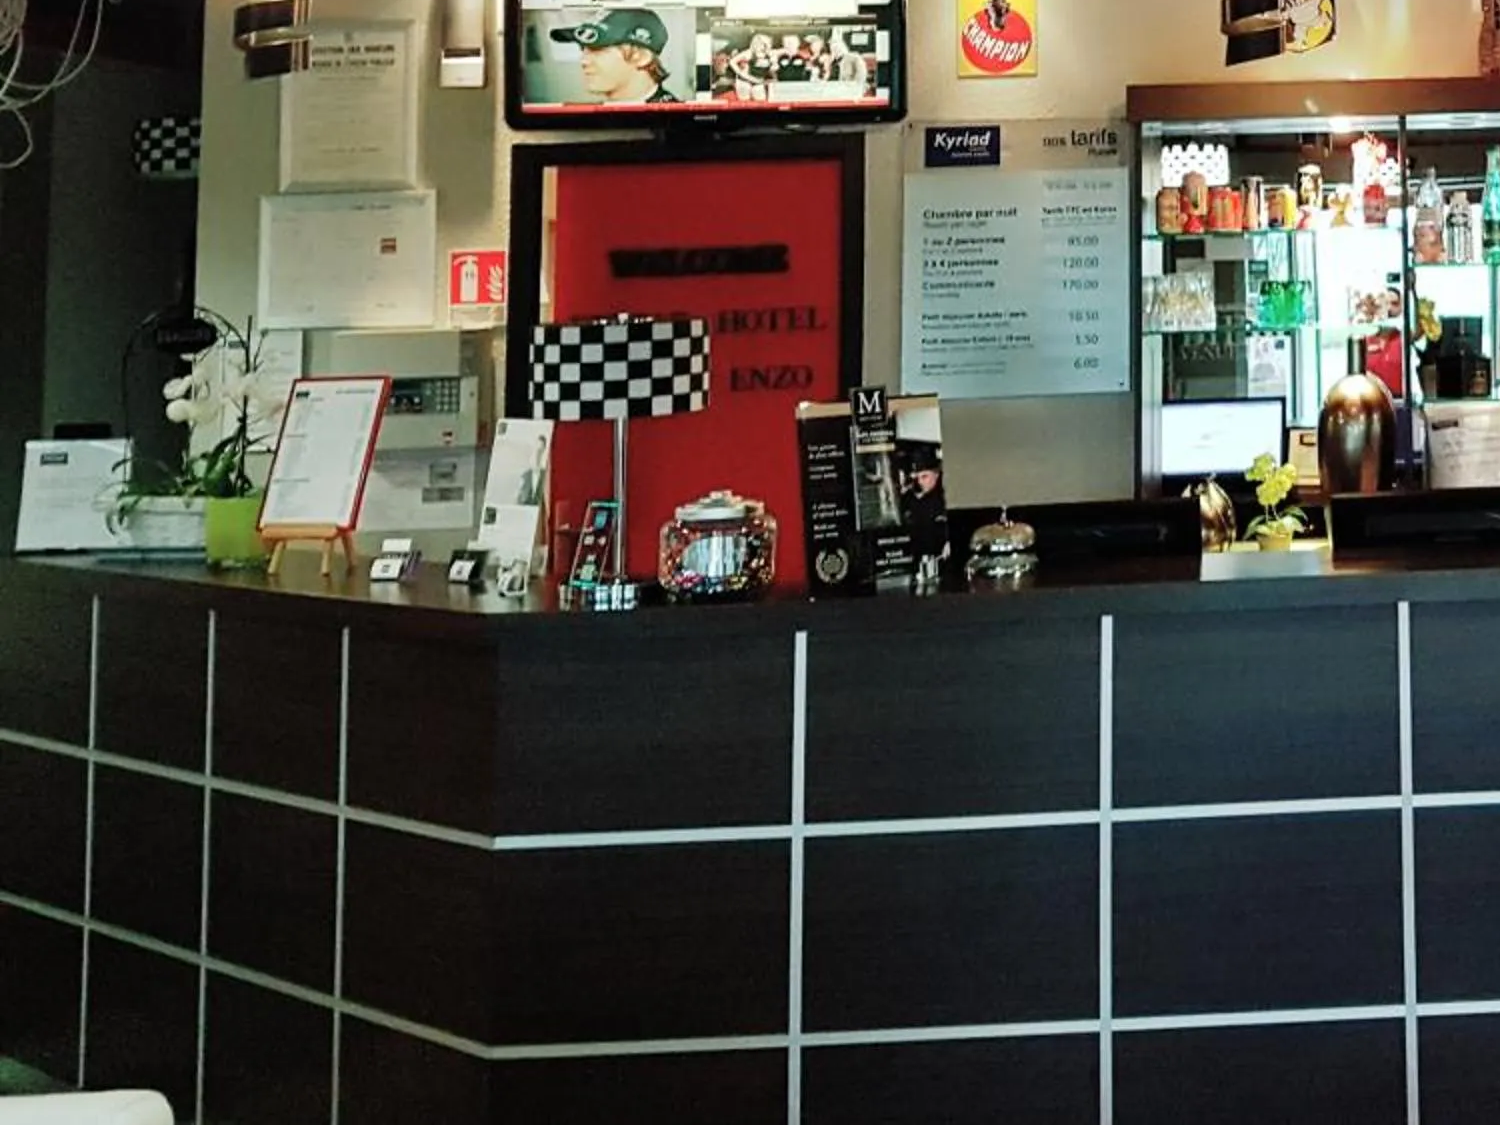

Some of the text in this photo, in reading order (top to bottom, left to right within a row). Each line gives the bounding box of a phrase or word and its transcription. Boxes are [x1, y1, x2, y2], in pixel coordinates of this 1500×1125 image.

[963, 17, 1030, 63] CHAMPION
[934, 130, 992, 152] Kyriad
[1043, 128, 1118, 147] nos tarifs
[717, 305, 827, 334] HOTEL
[729, 364, 815, 392] ENZO
[857, 390, 883, 415] M
